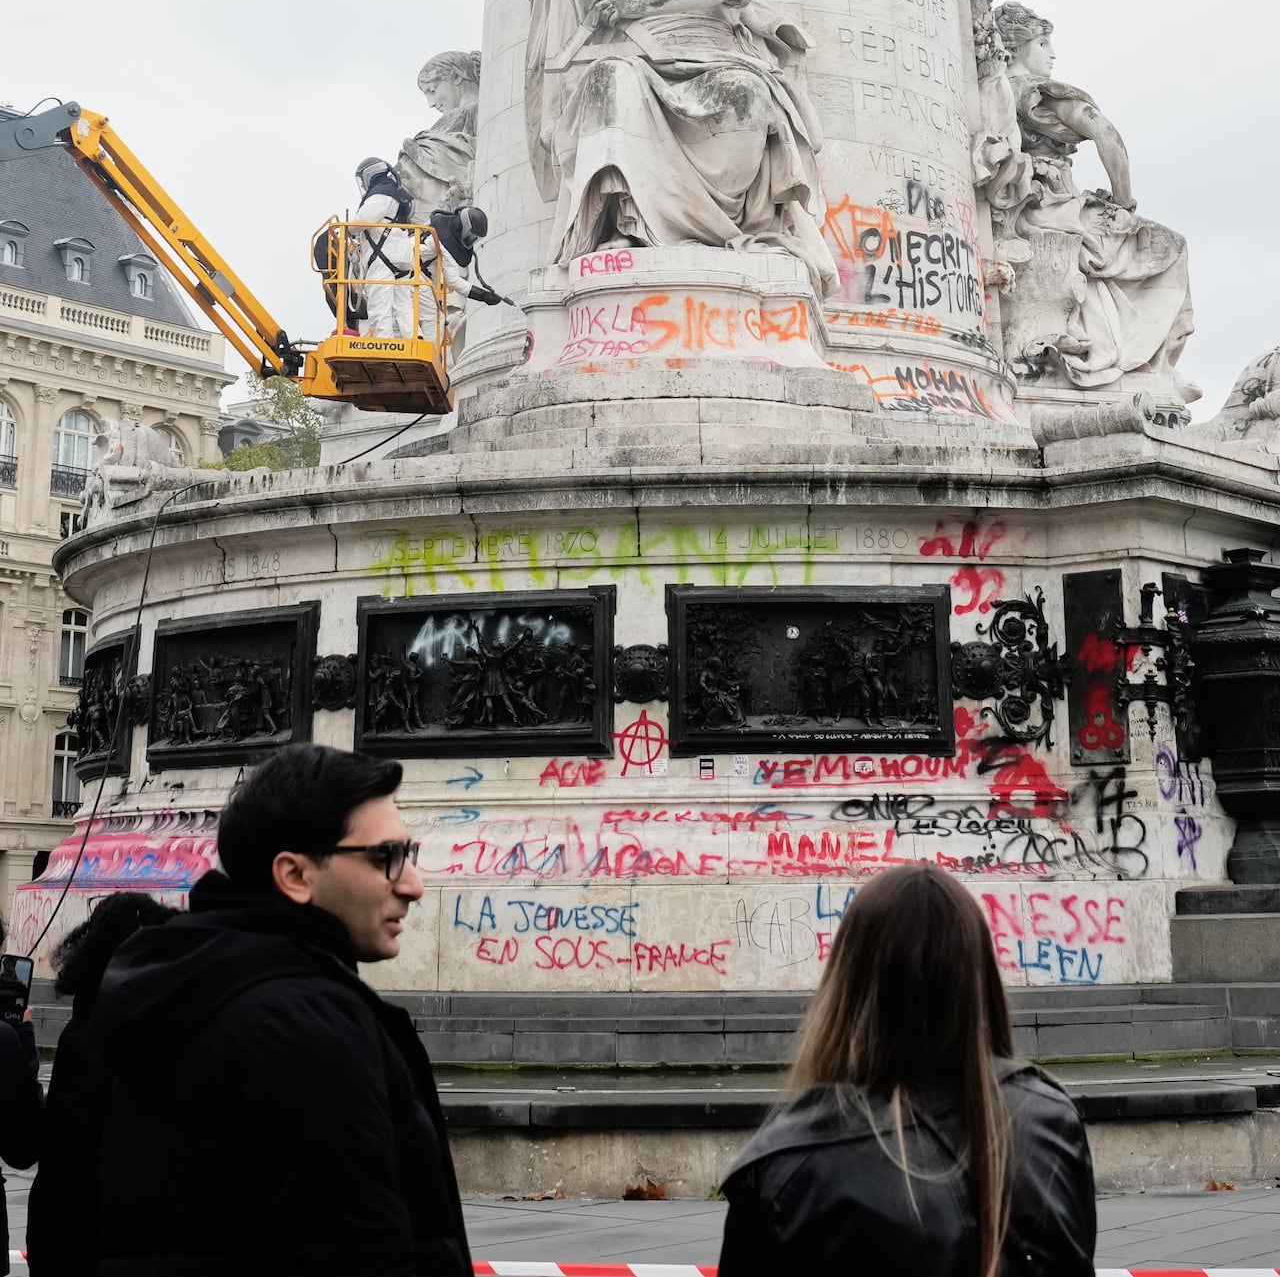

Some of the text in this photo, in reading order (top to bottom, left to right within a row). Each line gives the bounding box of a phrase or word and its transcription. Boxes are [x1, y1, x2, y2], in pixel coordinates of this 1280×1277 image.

[868, 150, 921, 182] VILLE
[927, 164, 948, 192] DE
[580, 249, 634, 277] ACAB
[907, 229, 974, 274] ECRIT
[371, 531, 597, 562] 4 SEPTEMBRE 1870
[707, 527, 729, 550] 14
[738, 526, 844, 550] JUILLET
[855, 526, 909, 549] 1880
[246, 551, 281, 576] 1848
[454, 894, 640, 937] LA JEUNESSE
[730, 896, 818, 970] ACAB
[476, 936, 519, 965] EN
[1056, 944, 1104, 982] FN
